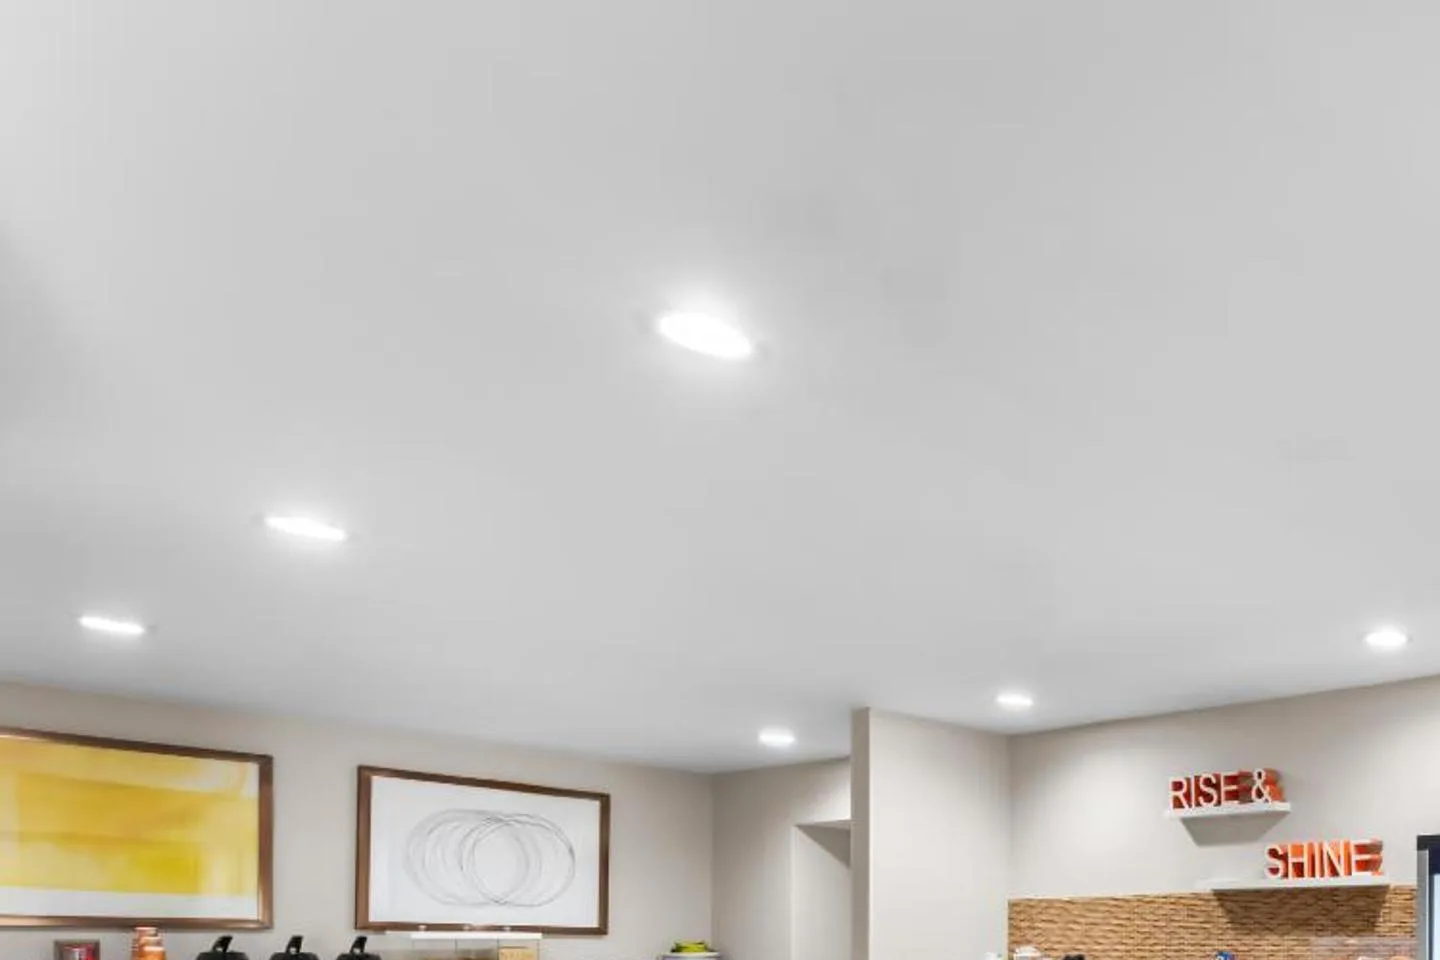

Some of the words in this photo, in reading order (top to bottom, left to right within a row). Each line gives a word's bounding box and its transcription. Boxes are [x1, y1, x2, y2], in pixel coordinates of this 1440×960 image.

[1168, 770, 1242, 810] RISE
[1251, 767, 1278, 804] &
[1264, 839, 1380, 880] SHINE
